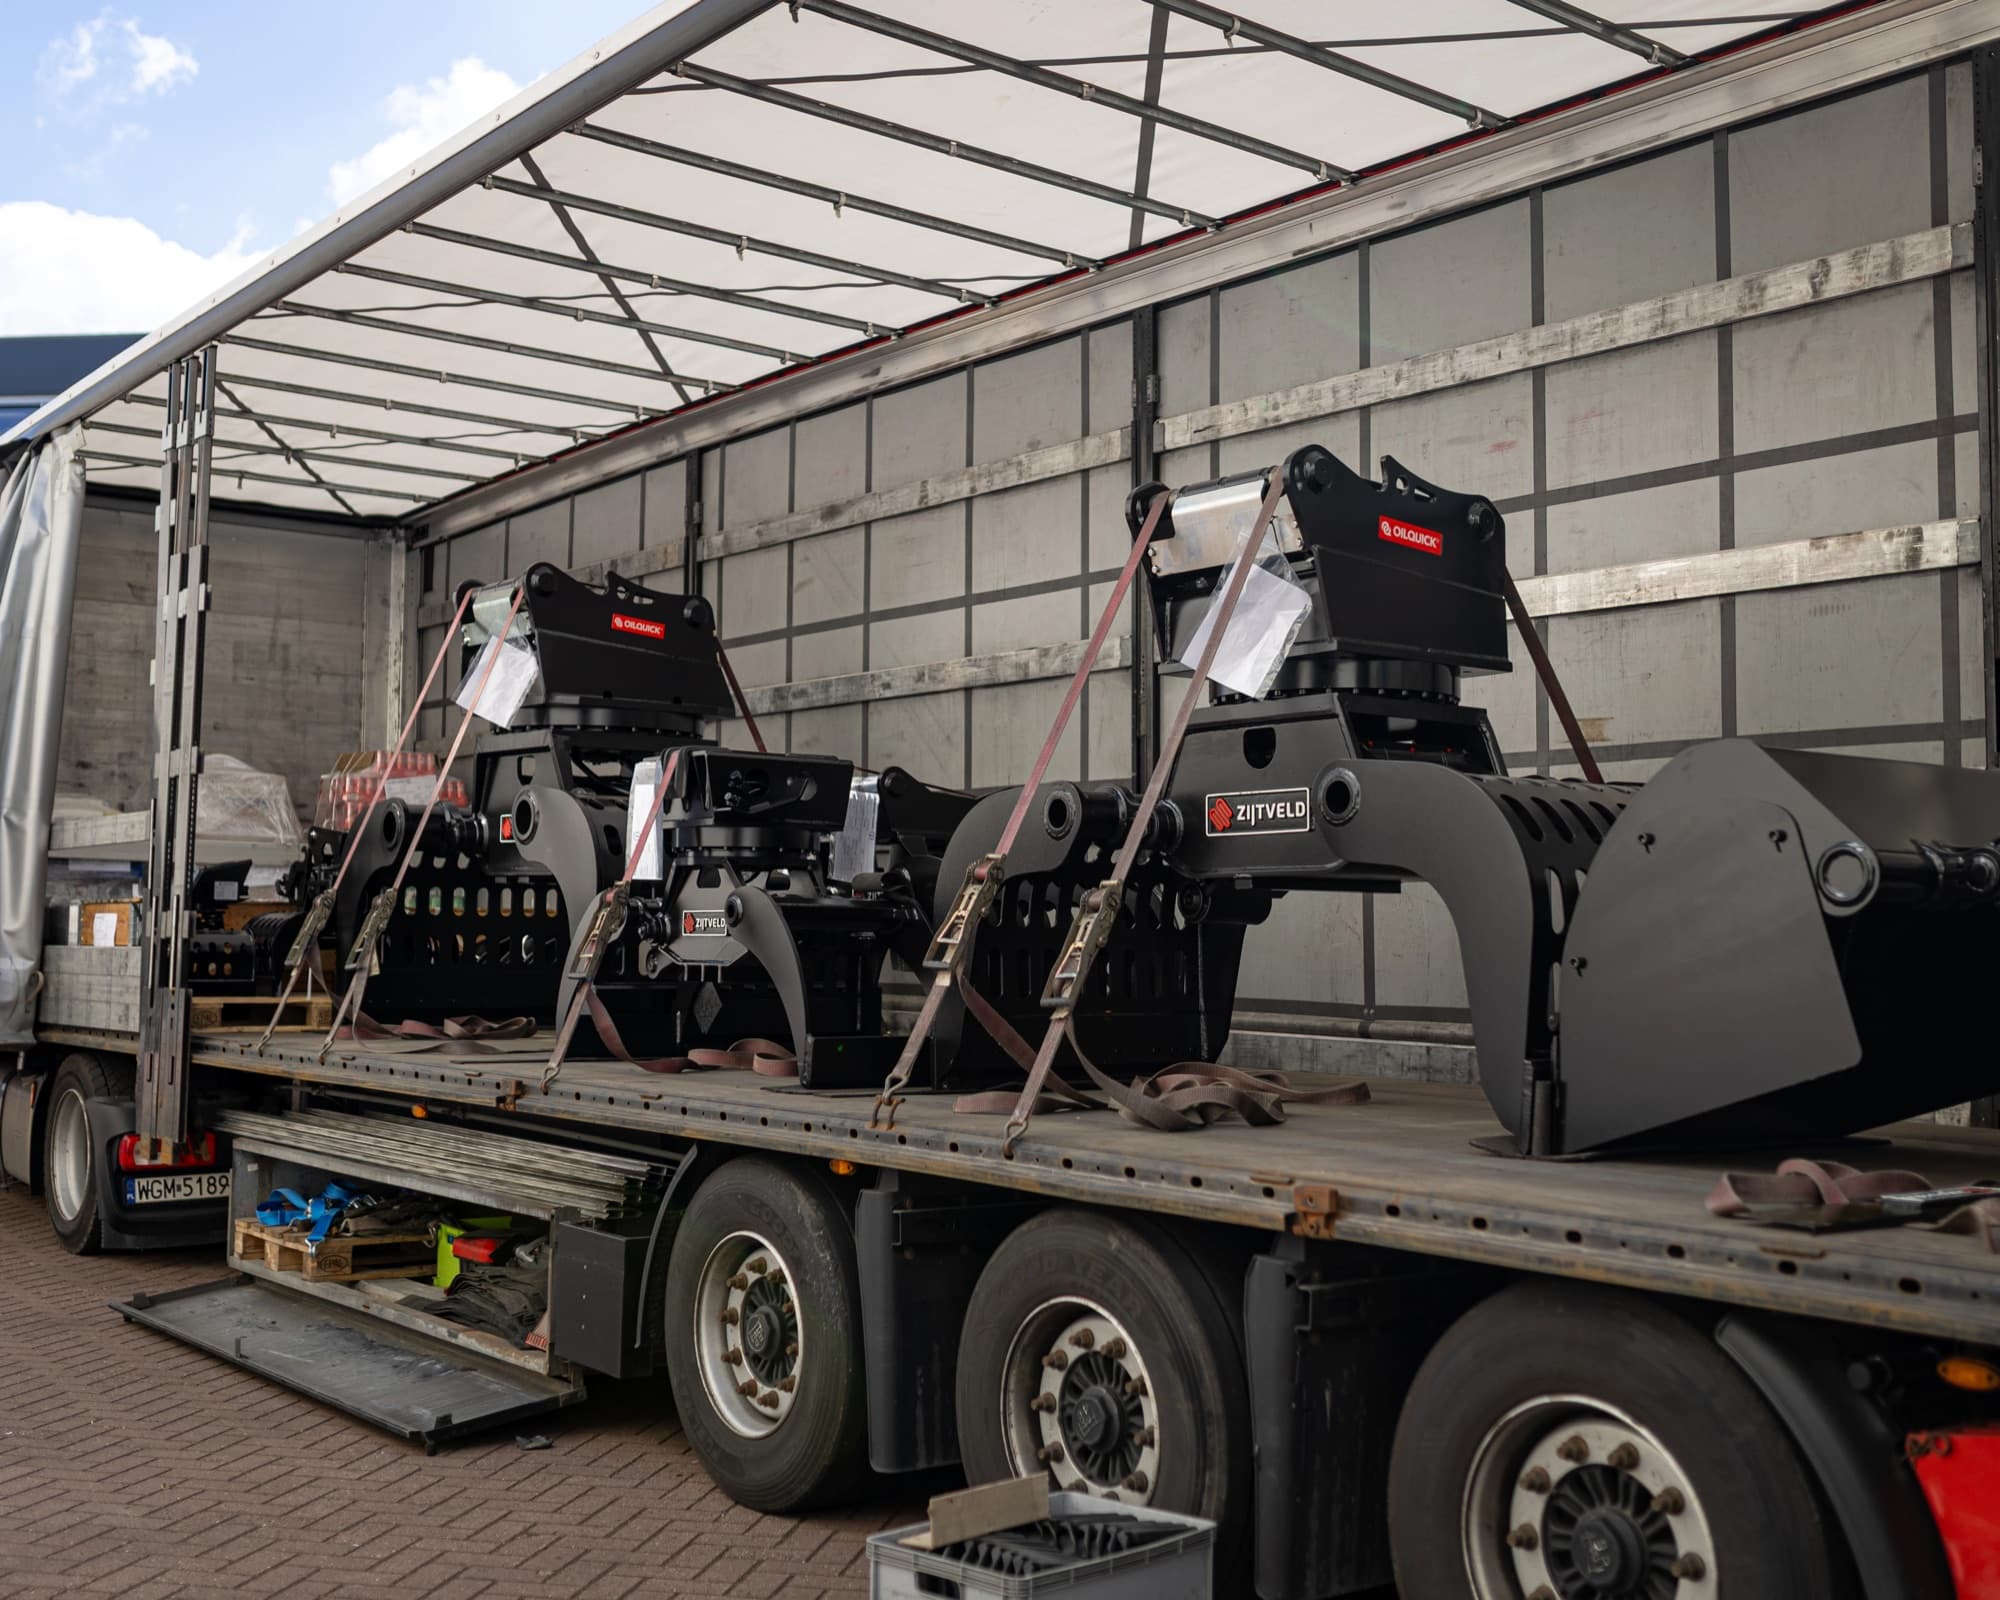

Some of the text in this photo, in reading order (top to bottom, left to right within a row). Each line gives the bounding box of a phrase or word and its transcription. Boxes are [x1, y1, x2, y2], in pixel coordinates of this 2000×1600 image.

[1392, 525, 1437, 549] OILQUICK
[623, 620, 660, 635] OILQUICK
[1236, 801, 1306, 827] ZIJTVELD
[695, 917, 726, 931] ZIJTVELD
[137, 1178, 176, 1201] WGM
